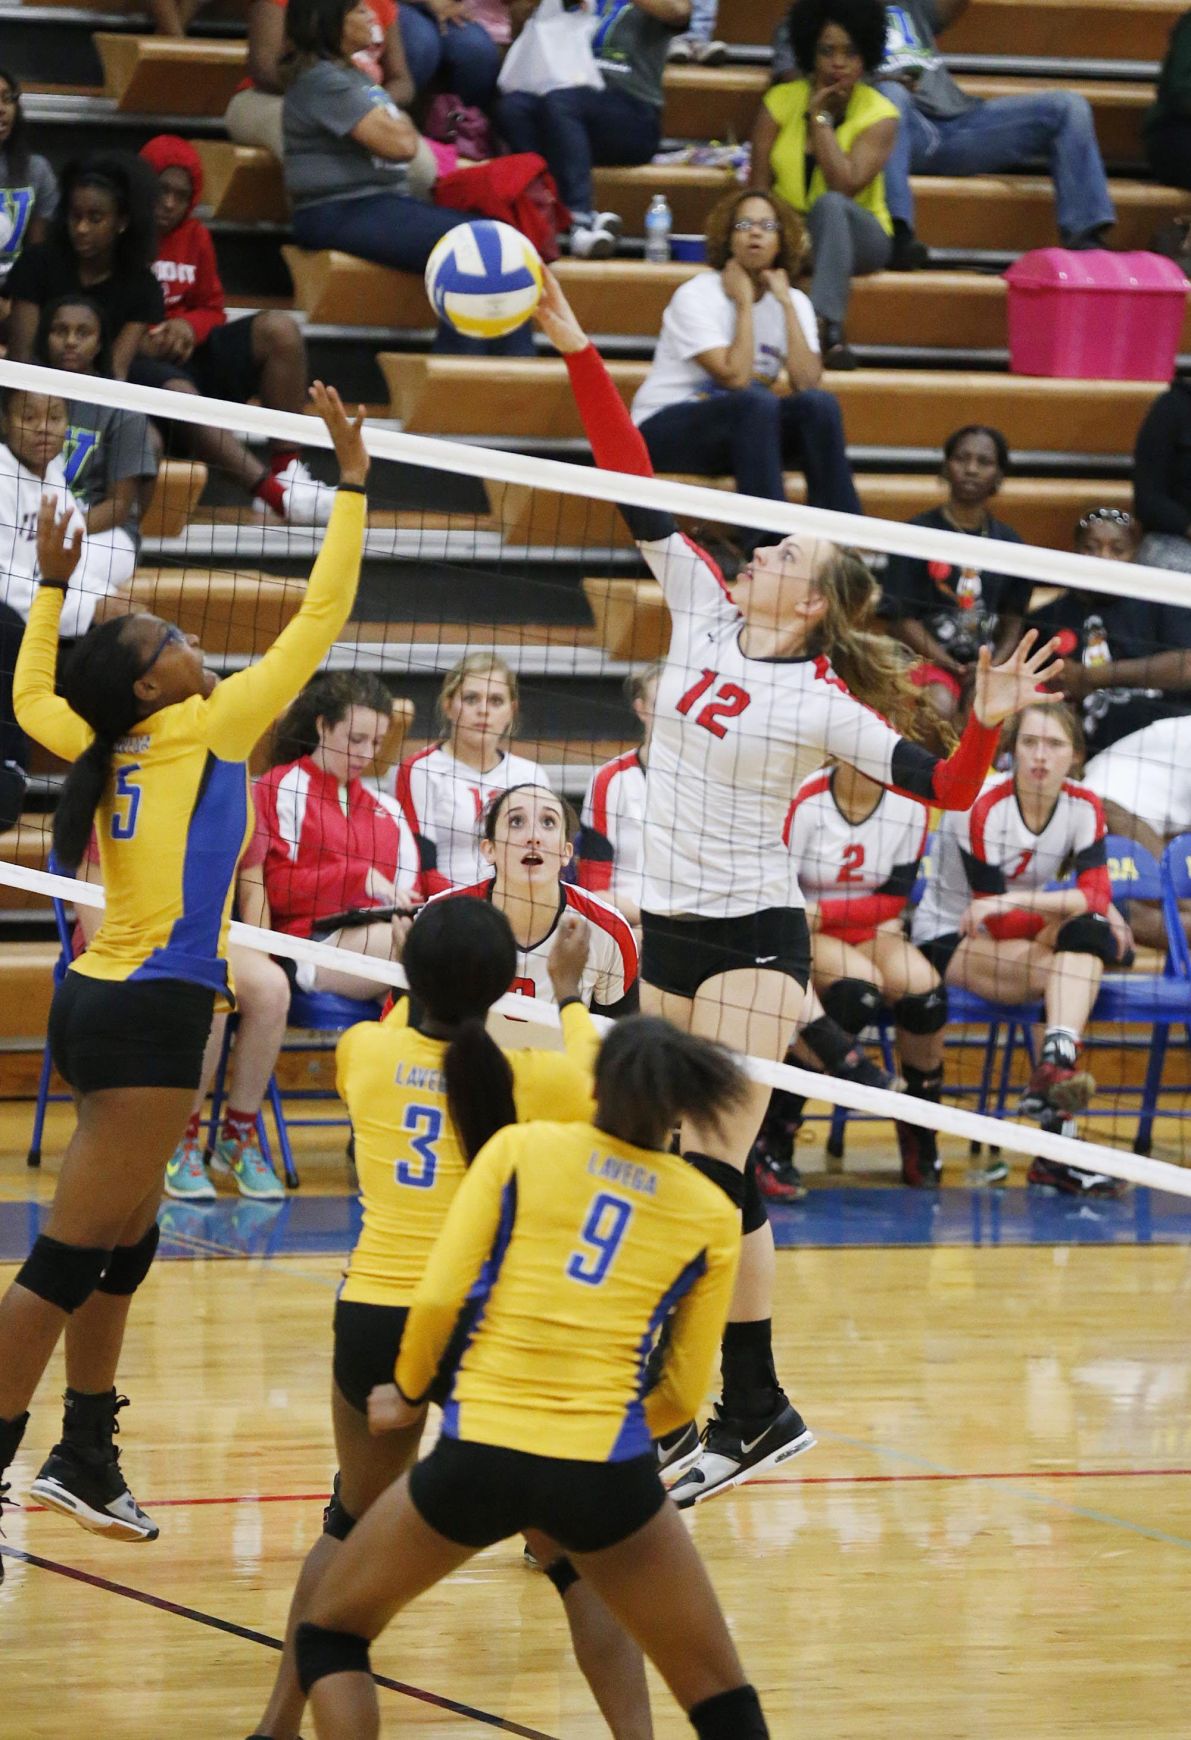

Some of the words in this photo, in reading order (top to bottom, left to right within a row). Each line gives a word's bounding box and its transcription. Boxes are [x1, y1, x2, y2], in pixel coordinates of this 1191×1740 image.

[675, 667, 751, 739] 12
[110, 763, 142, 839] 5
[836, 843, 866, 882] 2
[395, 1061, 448, 1093] LAVE
[395, 1104, 442, 1188] 3
[587, 1150, 658, 1195] LAVEGA
[566, 1192, 633, 1285] 9
